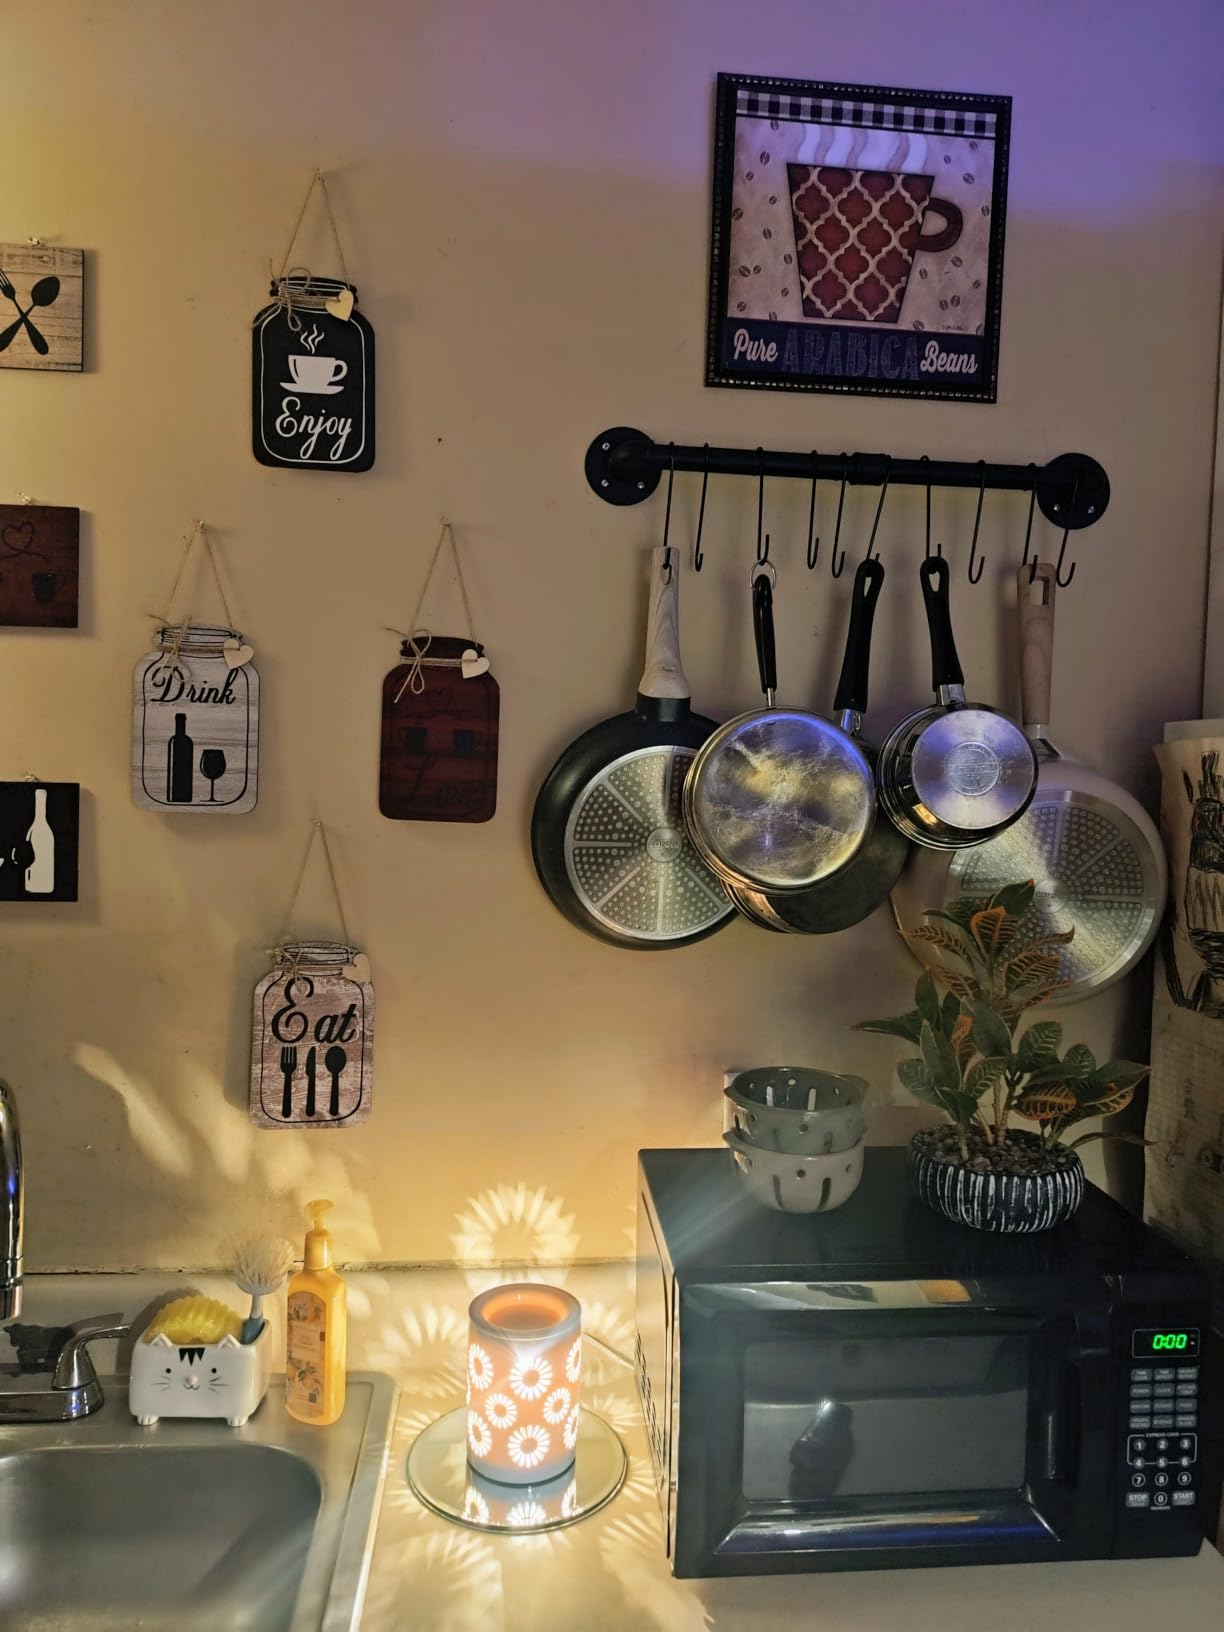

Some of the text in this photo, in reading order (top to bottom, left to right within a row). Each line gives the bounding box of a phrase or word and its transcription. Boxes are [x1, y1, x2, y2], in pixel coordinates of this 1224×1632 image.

[733, 328, 978, 381] Pure ARABICA Beans
[275, 396, 352, 461] Enjoy
[151, 665, 237, 705] Drink
[271, 976, 358, 1044] Eat
[1153, 1334, 1187, 1349] 0:00
[1173, 1492, 1193, 1500] START
